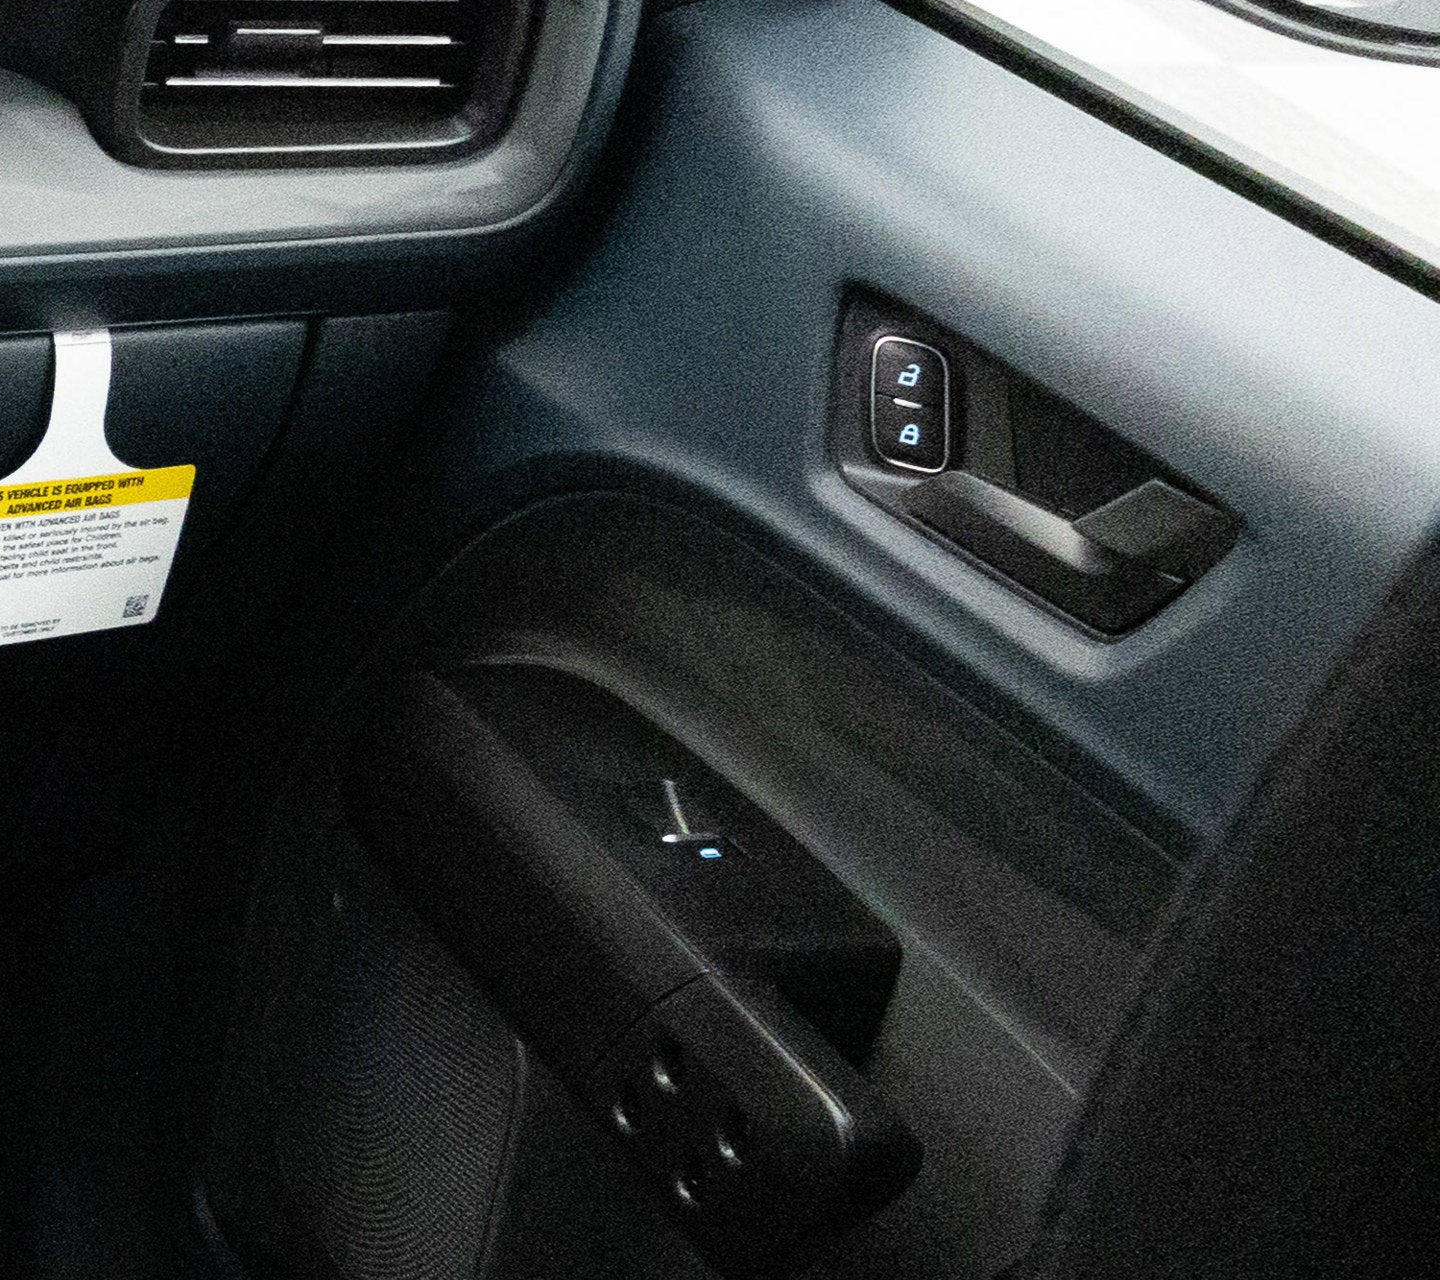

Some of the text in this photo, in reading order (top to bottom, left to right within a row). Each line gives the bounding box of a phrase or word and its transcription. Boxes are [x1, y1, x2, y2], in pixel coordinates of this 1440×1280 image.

[6, 486, 49, 500] VEHICLE
[51, 484, 62, 495] IS
[64, 479, 115, 494] EQUIPPED
[117, 476, 145, 488] WITH
[6, 493, 113, 514] ADVANCED AIR BAGS
